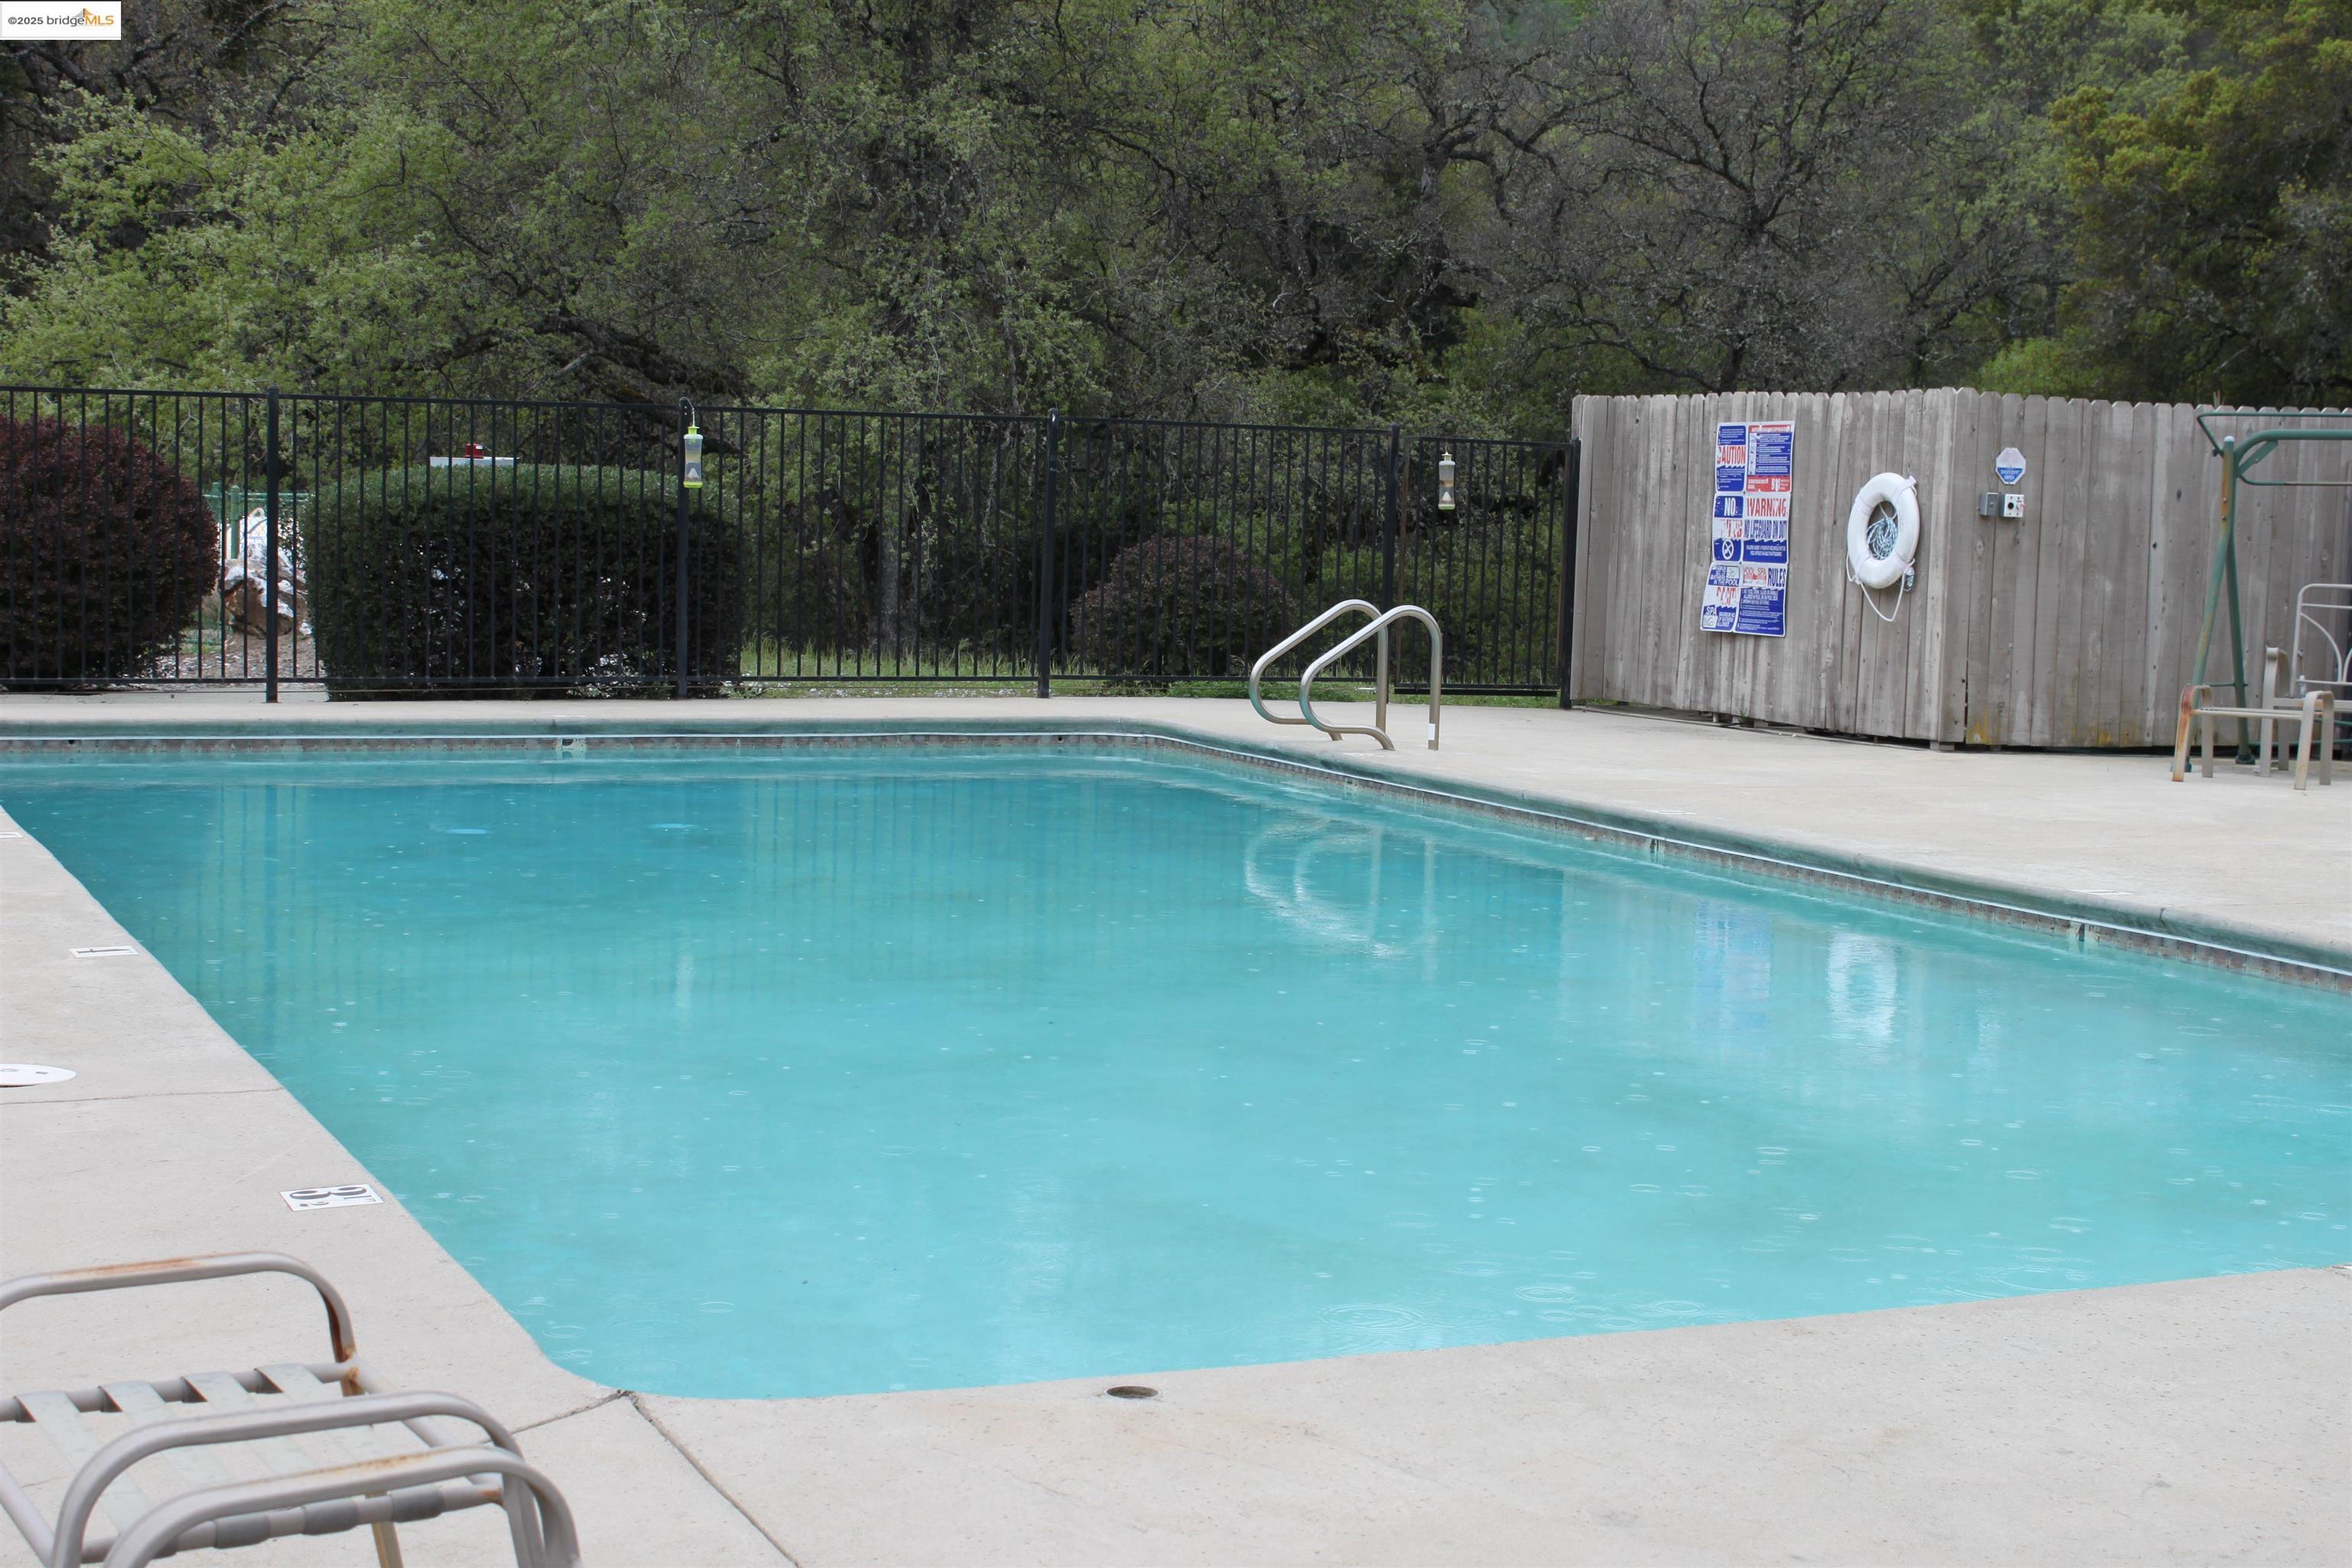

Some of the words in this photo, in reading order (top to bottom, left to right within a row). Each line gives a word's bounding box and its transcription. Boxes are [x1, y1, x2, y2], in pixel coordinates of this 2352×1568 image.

[1717, 446, 1746, 465] CAUTION
[1723, 498, 1736, 516] NO
[1747, 498, 1787, 517] WARNING
[1725, 578, 1739, 586] POOL
[1768, 568, 1786, 586] RULES
[1706, 606, 1717, 616] SPA
